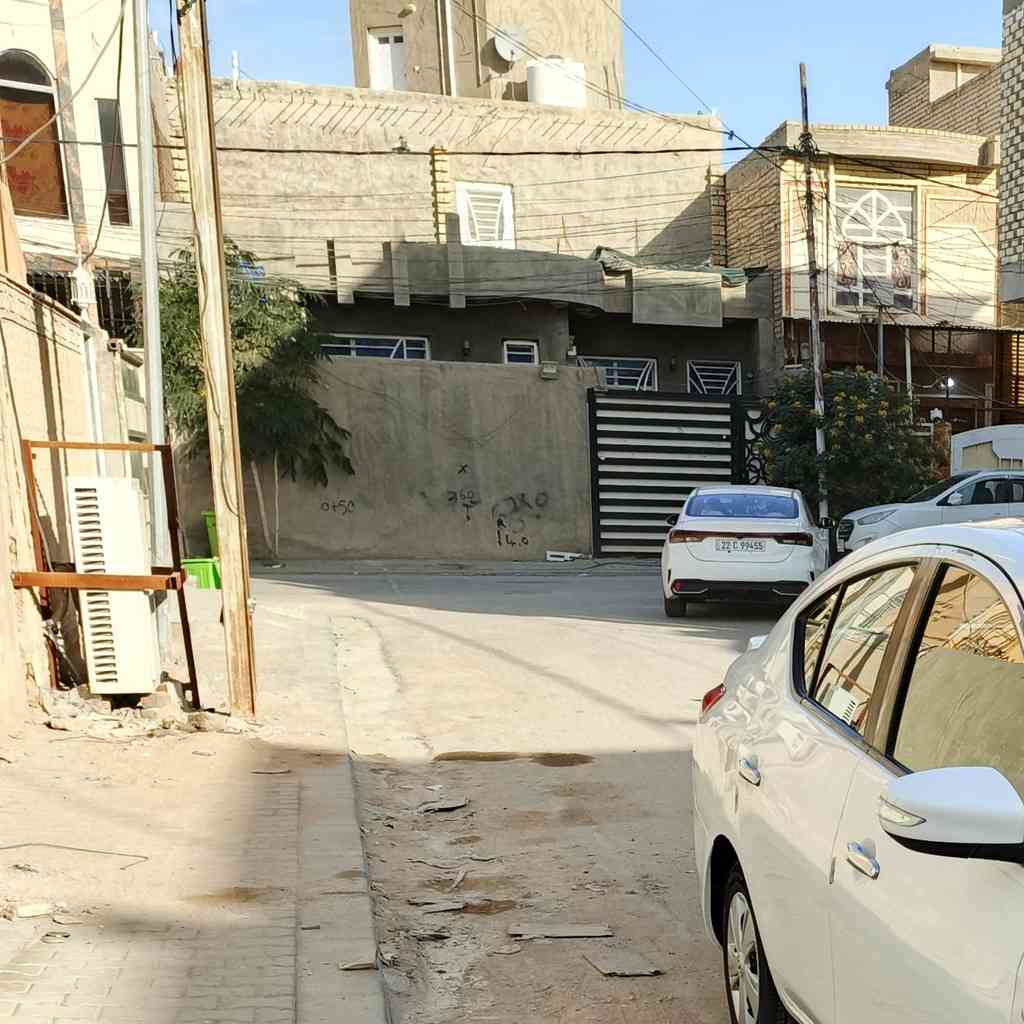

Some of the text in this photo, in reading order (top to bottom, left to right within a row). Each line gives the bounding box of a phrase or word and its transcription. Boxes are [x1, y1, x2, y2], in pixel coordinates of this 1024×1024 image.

[721, 541, 764, 551] 22 C 99455
